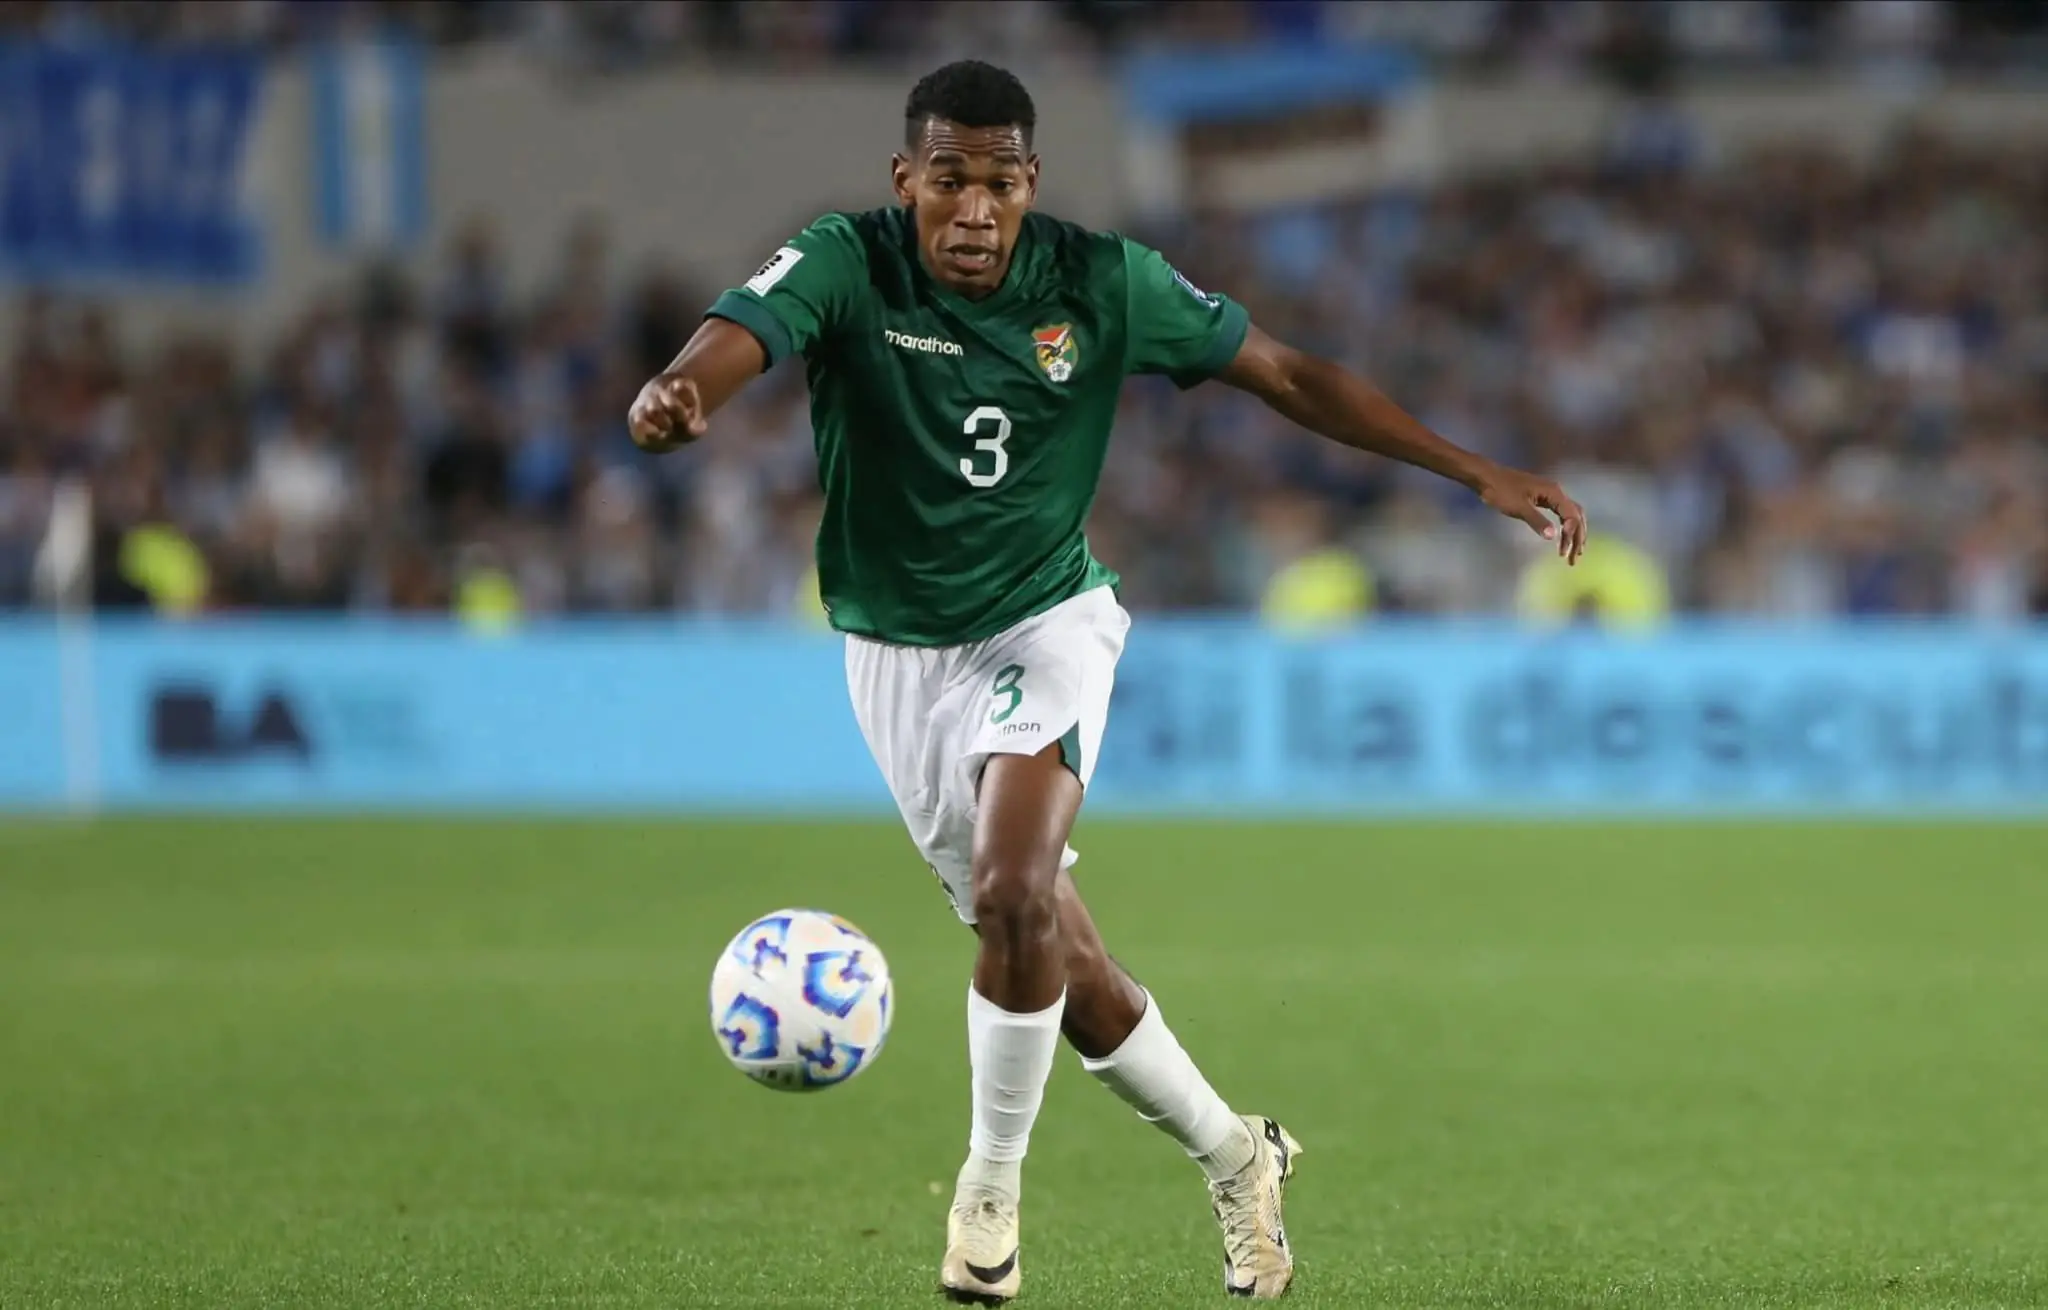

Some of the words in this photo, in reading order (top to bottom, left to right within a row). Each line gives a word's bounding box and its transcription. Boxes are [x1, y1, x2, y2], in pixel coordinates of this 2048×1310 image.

[884, 329, 964, 356] marathon
[960, 406, 1012, 487] 3
[990, 663, 1025, 725] 3
